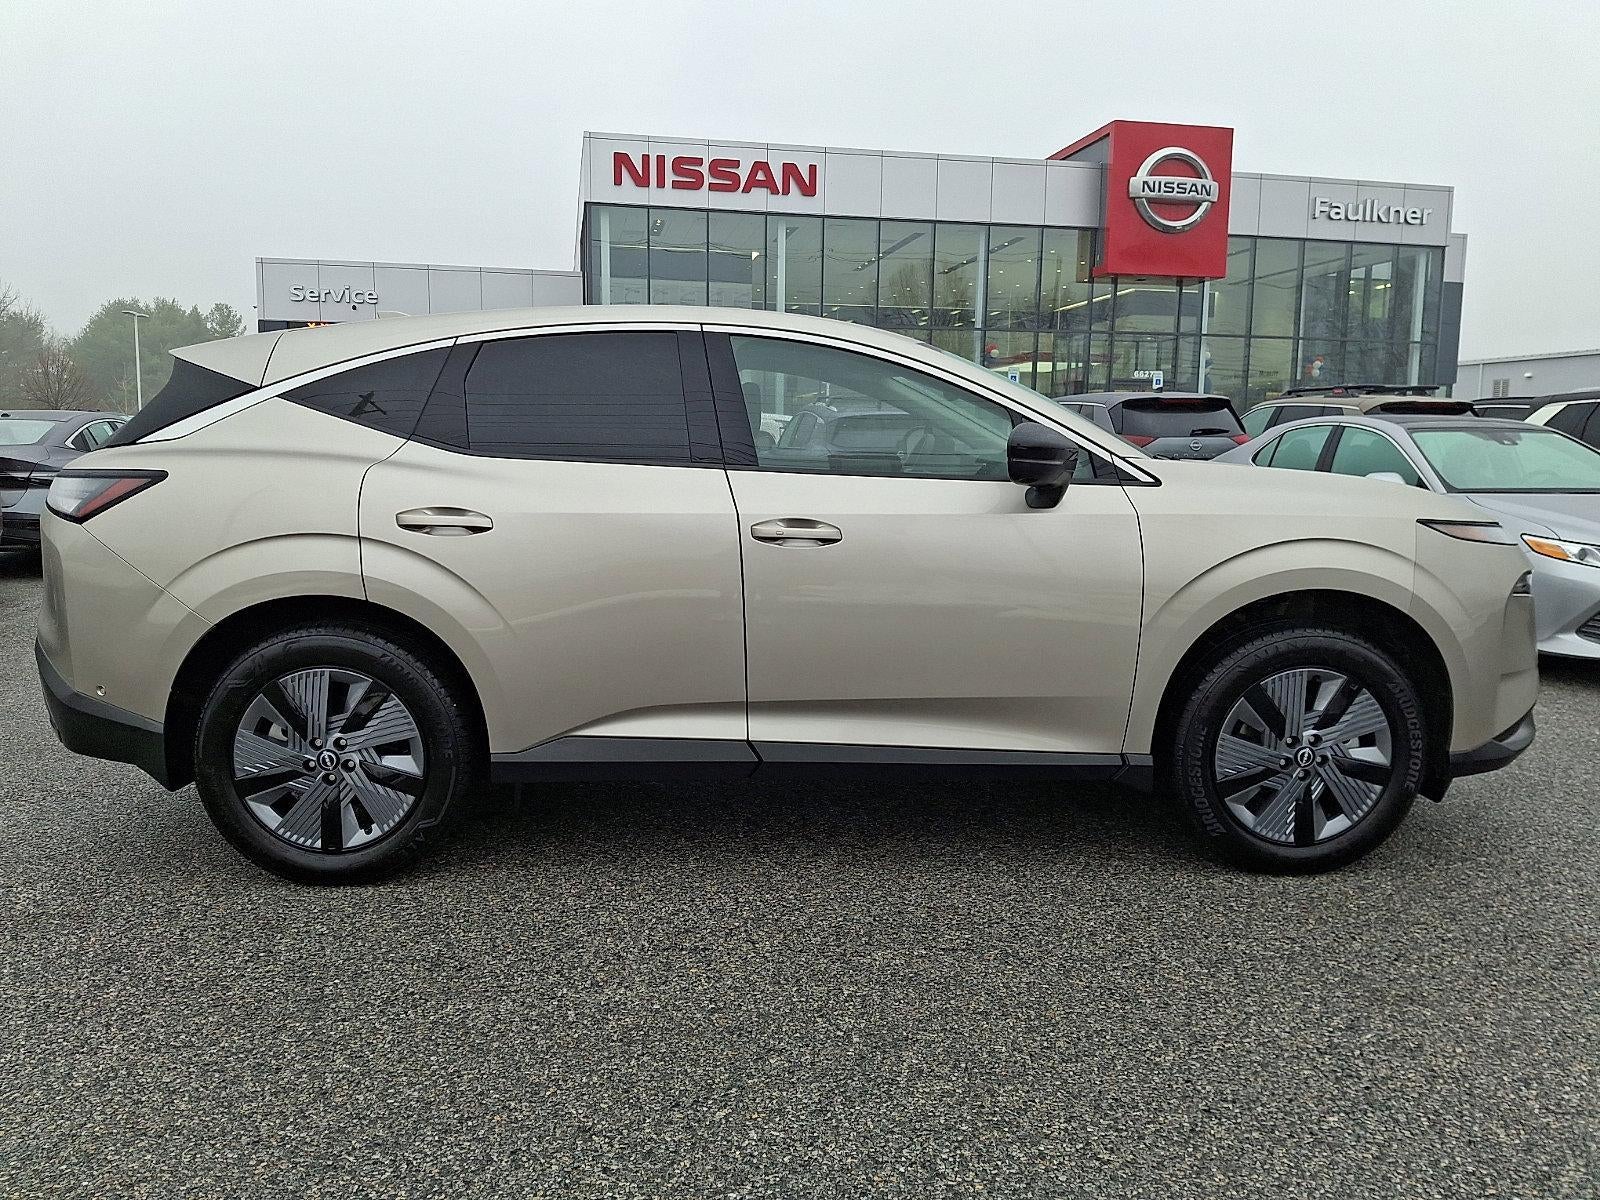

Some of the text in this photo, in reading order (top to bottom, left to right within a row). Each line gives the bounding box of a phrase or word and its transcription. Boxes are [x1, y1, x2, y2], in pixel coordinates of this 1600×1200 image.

[613, 152, 818, 197] NISSAN
[1141, 180, 1213, 198] NISSAN
[1312, 196, 1433, 226] Faulkner
[289, 285, 378, 304] Service
[1133, 370, 1154, 378] 6627
[1389, 681, 1423, 792] BRIDGESTONE
[1187, 725, 1226, 837] BRIDGESTONE
